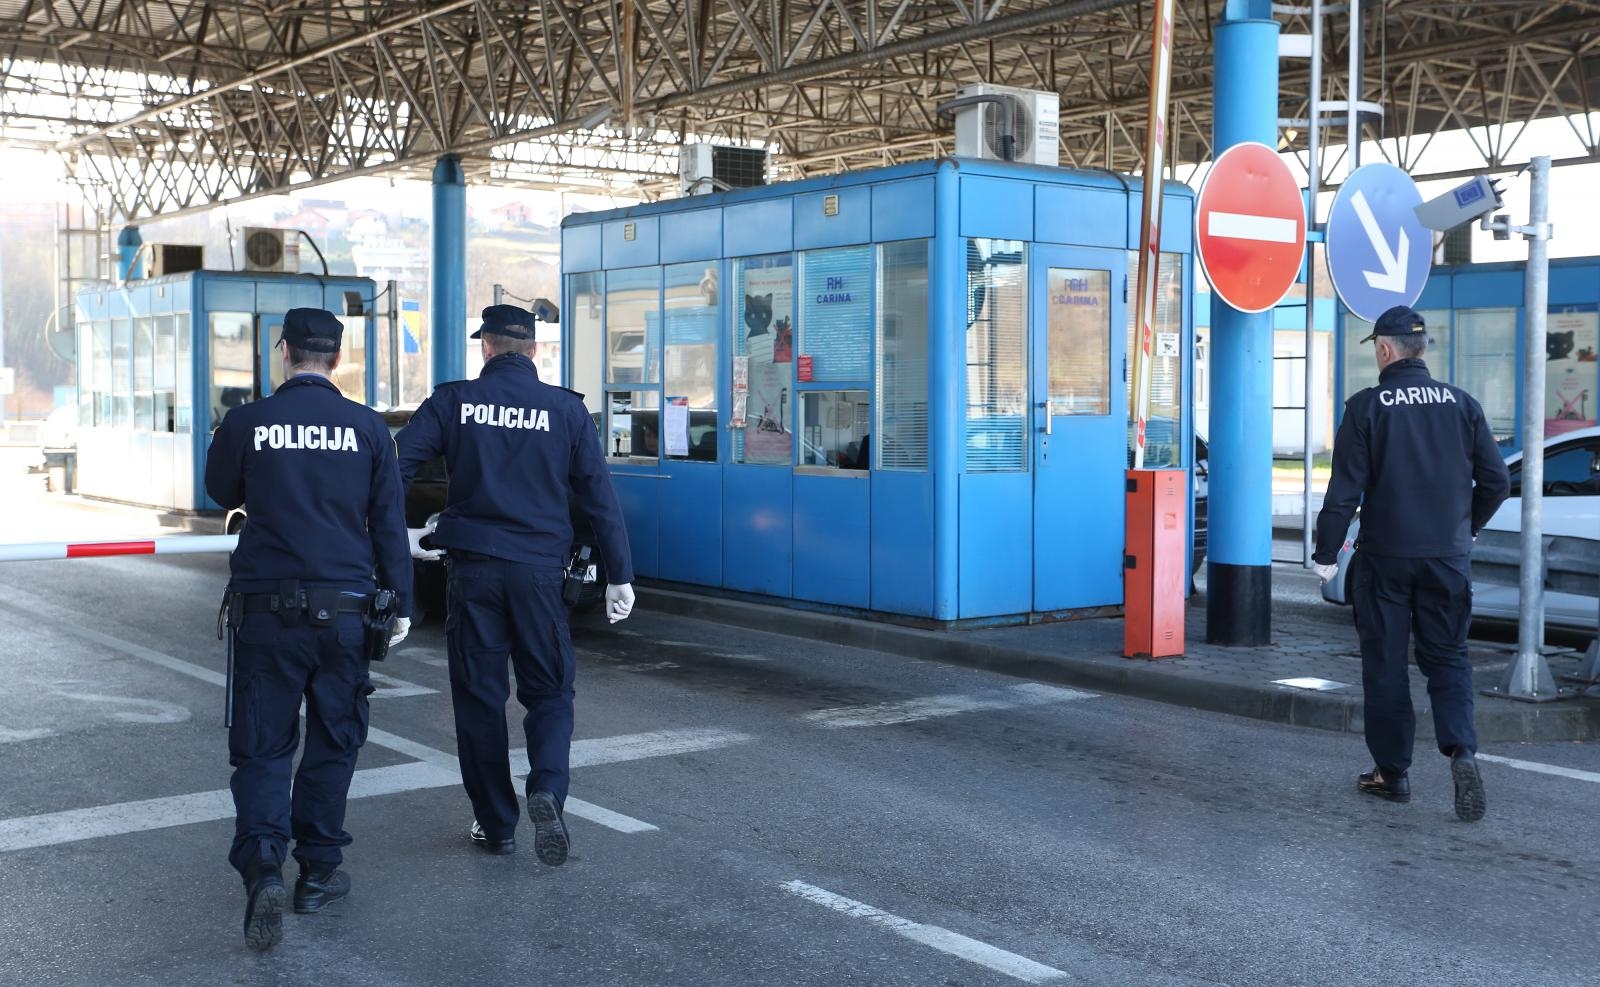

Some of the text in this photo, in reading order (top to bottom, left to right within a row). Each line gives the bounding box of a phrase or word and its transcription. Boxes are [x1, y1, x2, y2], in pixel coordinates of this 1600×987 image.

[827, 277, 843, 290] RH
[816, 293, 852, 304] CARINA
[1379, 386, 1457, 407] CARINA
[460, 402, 550, 432] POLICIJA
[254, 424, 358, 452] POLICIJA
